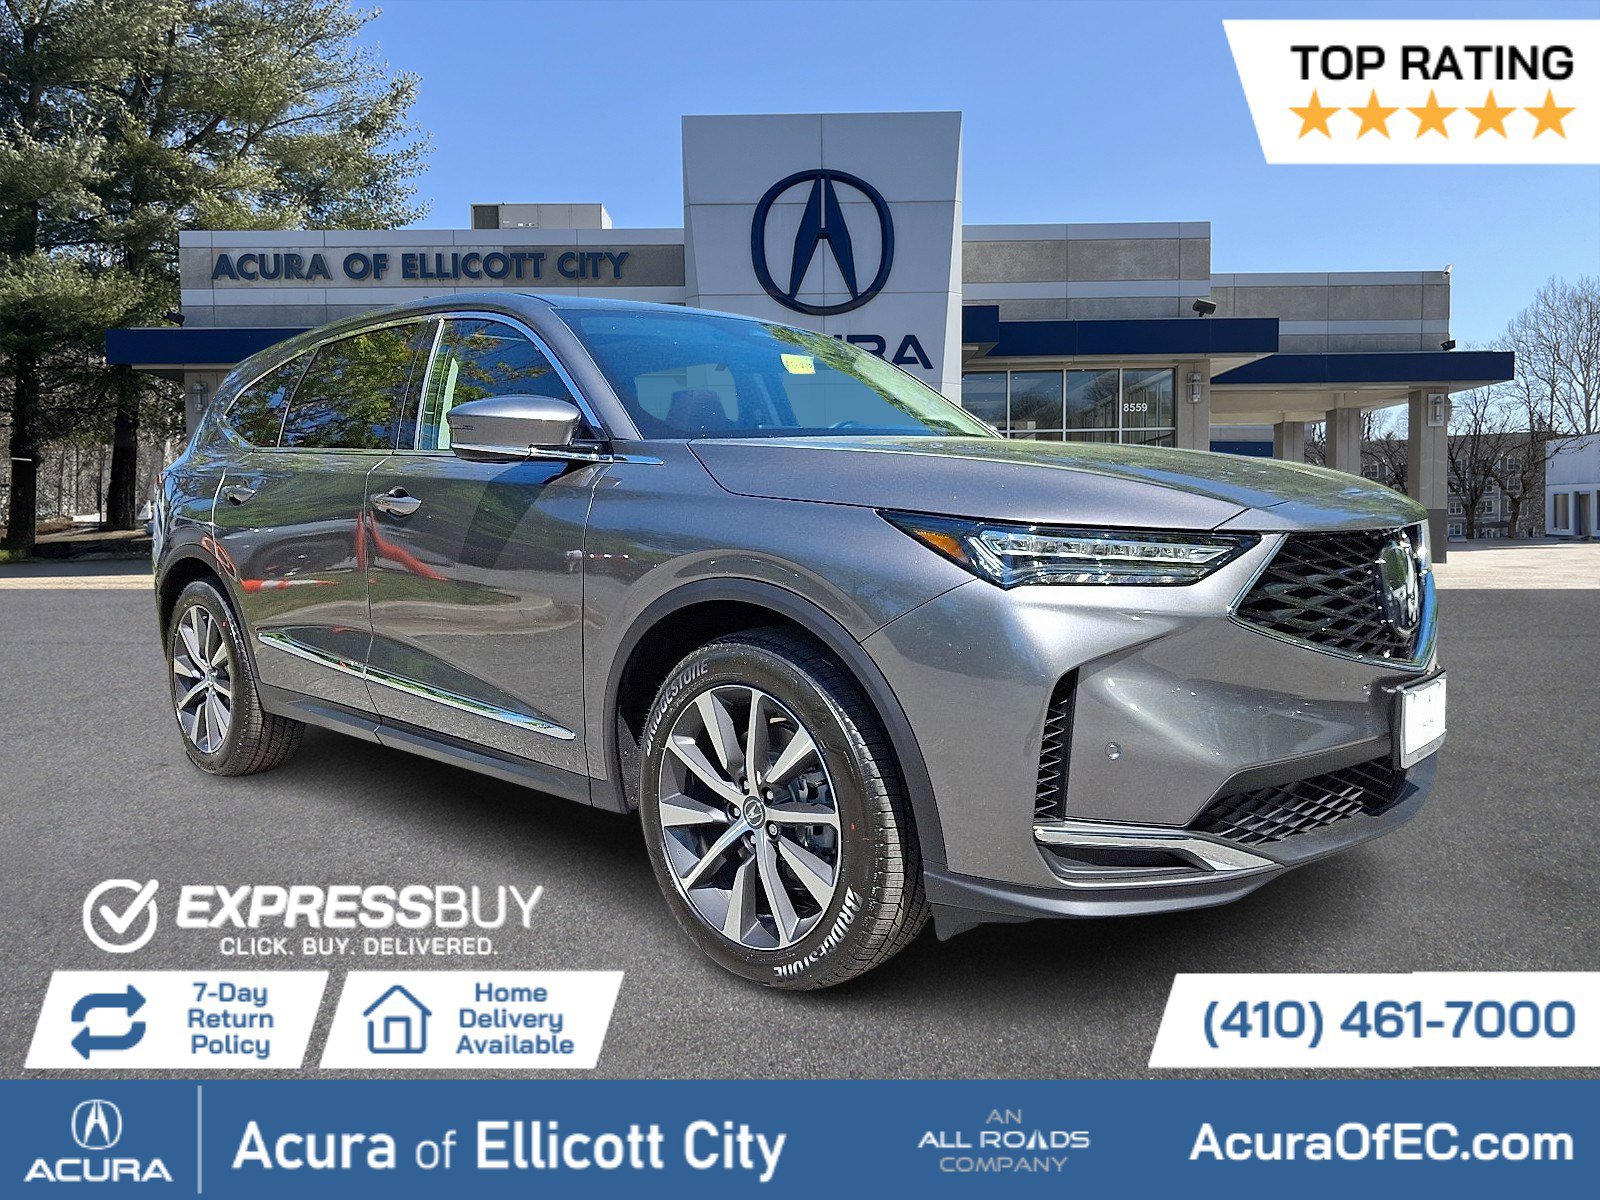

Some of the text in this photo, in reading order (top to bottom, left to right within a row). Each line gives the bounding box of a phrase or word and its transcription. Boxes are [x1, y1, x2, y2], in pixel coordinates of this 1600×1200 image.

[212, 250, 629, 281] ACURA OF ELLICOTT CITY
[1123, 402, 1148, 413] 8559
